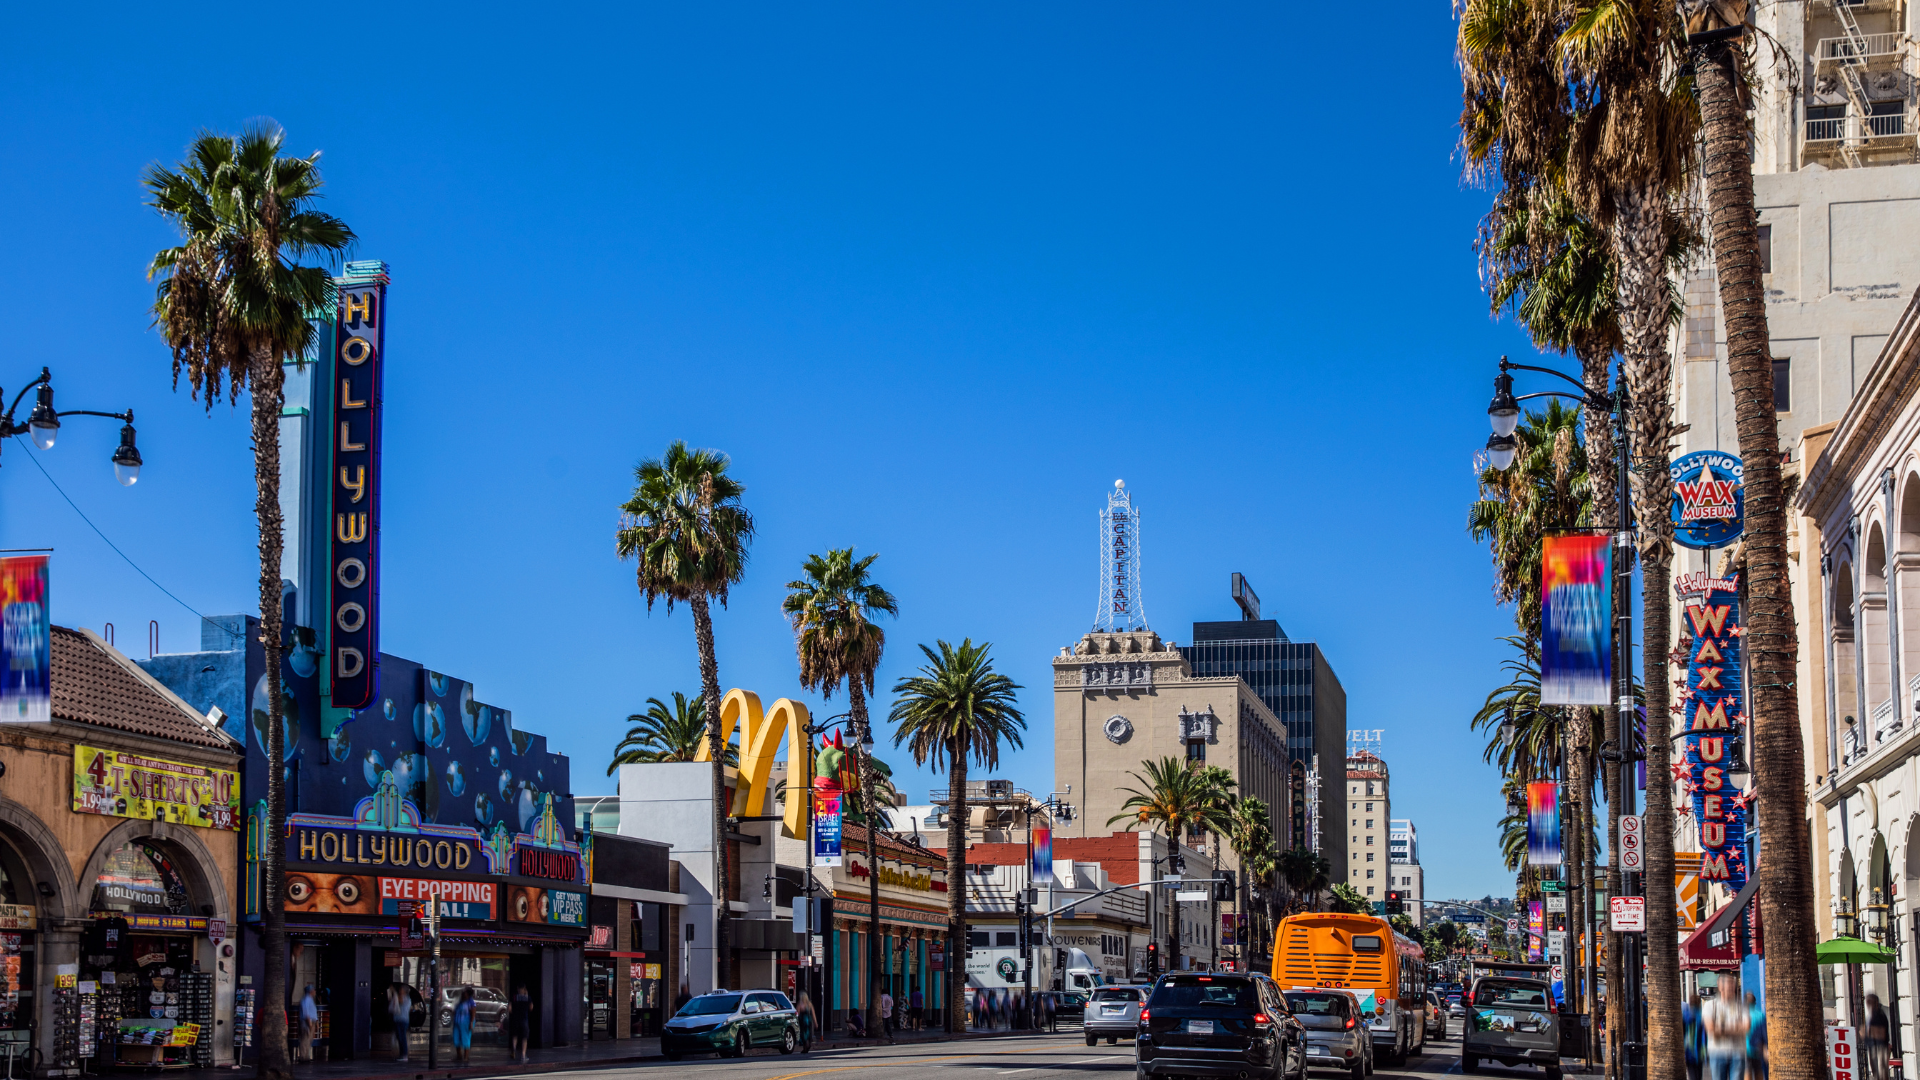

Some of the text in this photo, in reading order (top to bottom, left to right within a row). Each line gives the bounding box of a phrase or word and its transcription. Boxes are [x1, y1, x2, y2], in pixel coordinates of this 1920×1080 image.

[1670, 455, 1744, 482] OLLYWOO
[336, 292, 371, 679] HOLLYWOOD
[1677, 480, 1736, 506] WAX
[1112, 512, 1127, 521] EL
[1681, 505, 1736, 519] MUSEUM
[1113, 523, 1126, 613] CAPITAN
[1676, 571, 1740, 599] Hollywood
[1686, 603, 1731, 691] WAX
[148, 760, 157, 768] ANY
[87, 751, 108, 786] 4
[111, 766, 200, 807] T-SHIRTS
[1690, 697, 1732, 881] MUSEUM
[818, 813, 839, 823] ISRAEL
[300, 830, 471, 870] HOLLYWOOD
[521, 849, 577, 881] HOLLYWOOD
[106, 886, 161, 904] HOLLYWOOD
[382, 878, 491, 902] EYE POPPING
[555, 891, 581, 902] GET YOUR
[553, 899, 583, 915] VIP PASS
[1612, 904, 1622, 912] NO
[162, 917, 187, 928] STARS
[211, 920, 226, 932] ATM
[560, 914, 576, 923] HERE
[1054, 936, 1101, 946] OUVENIRS
